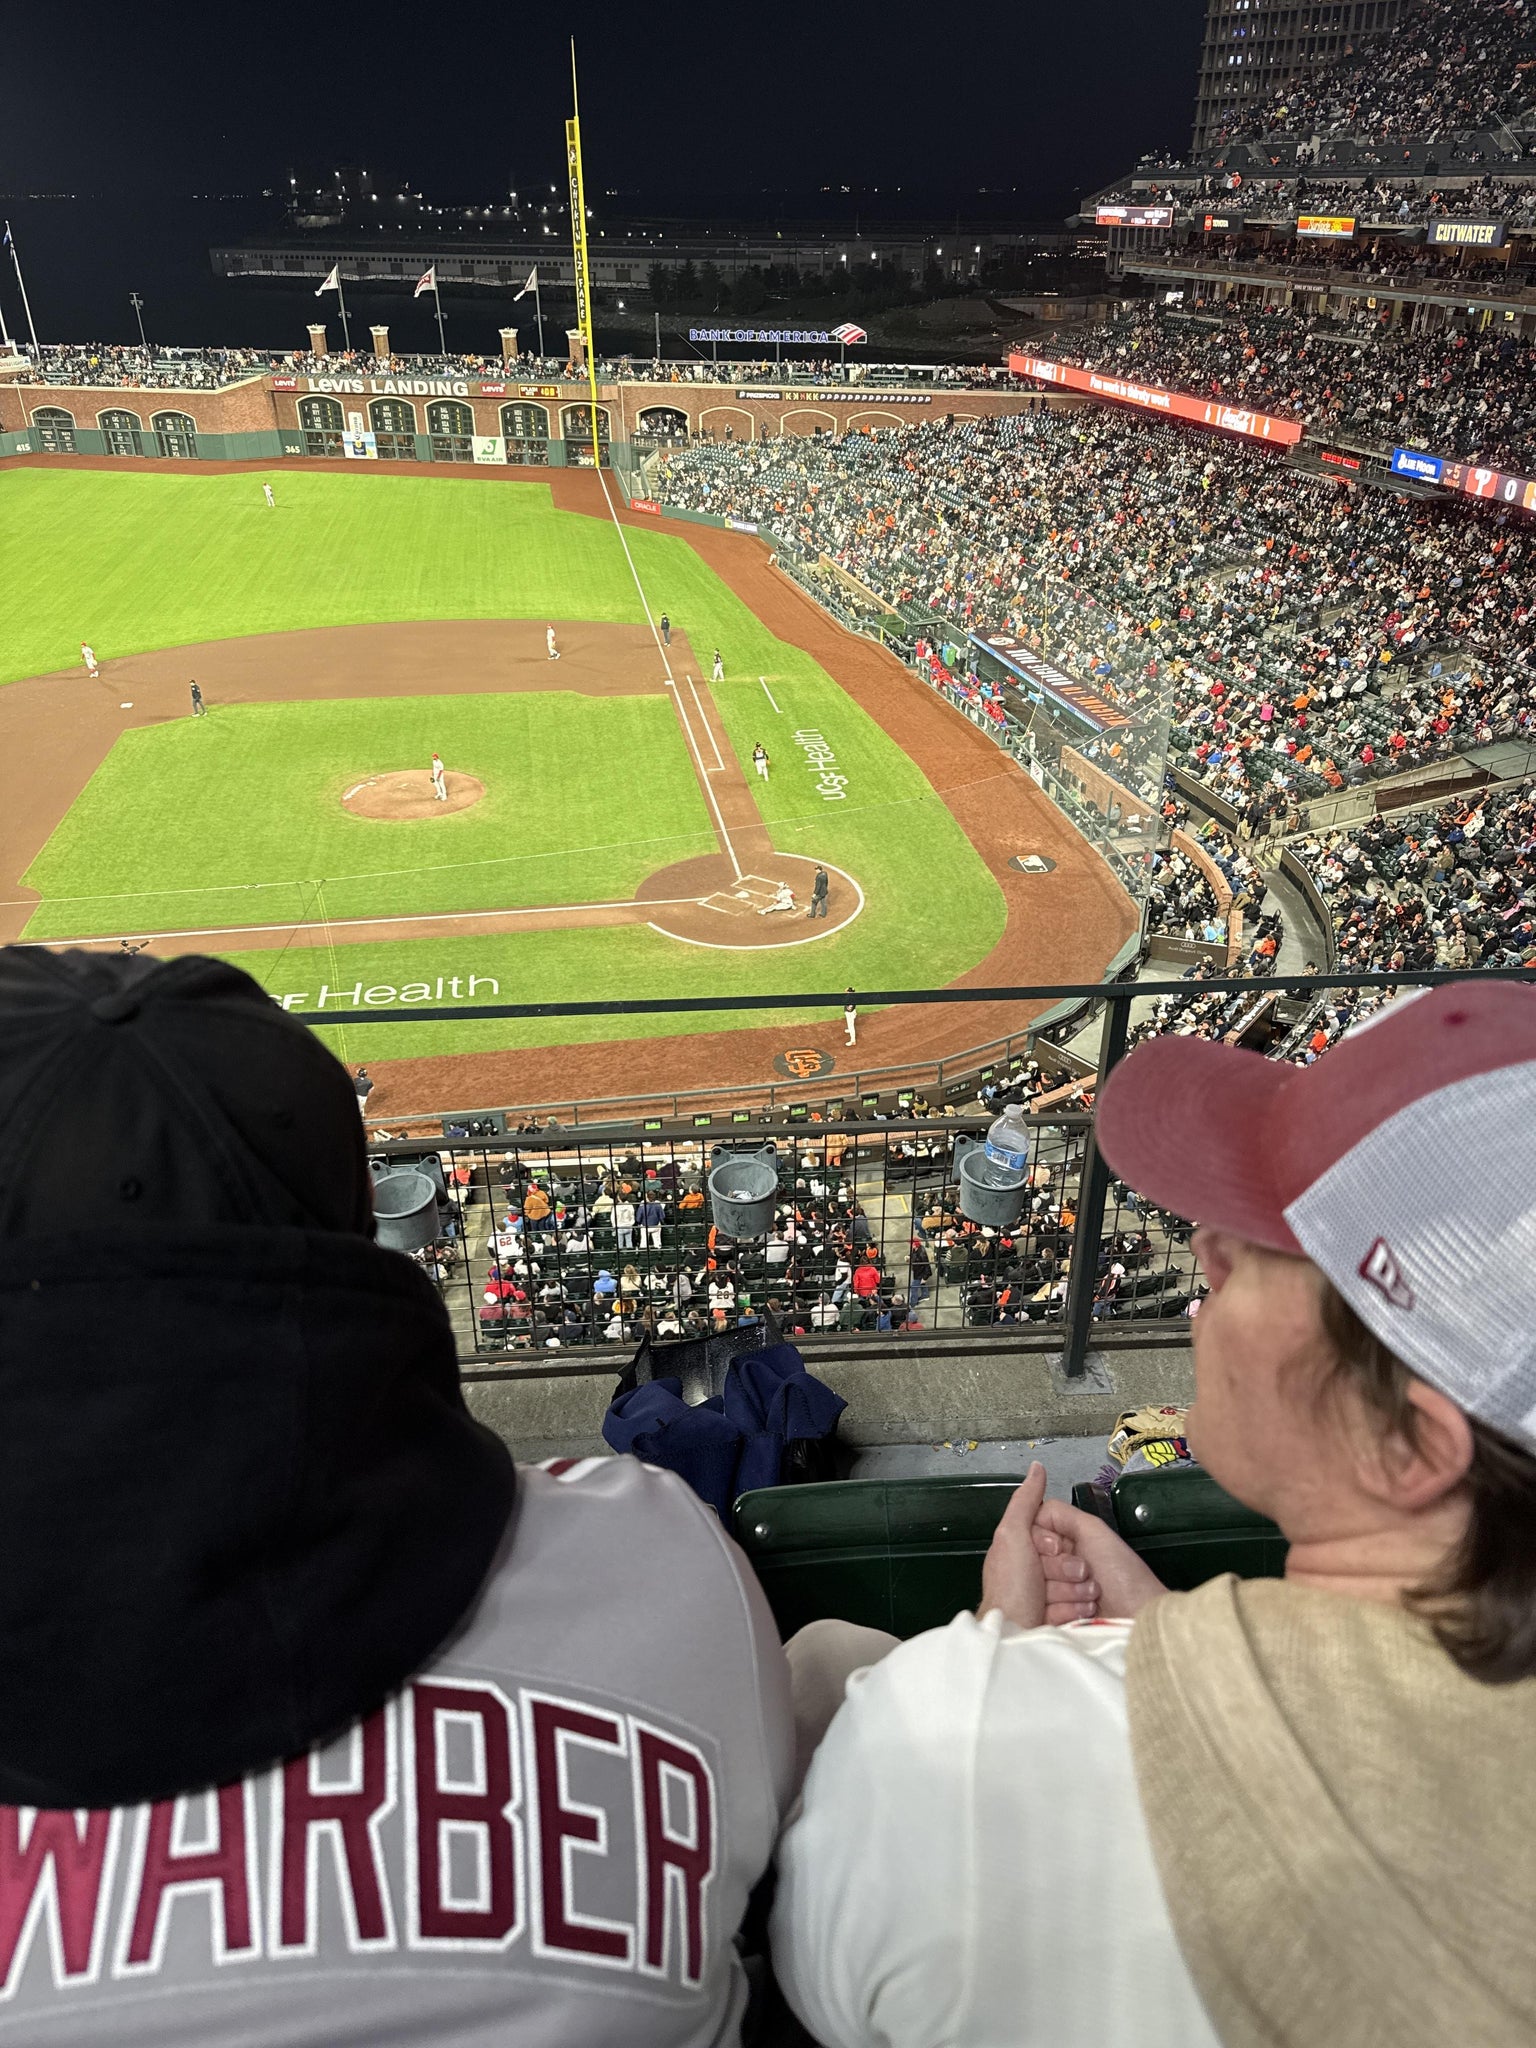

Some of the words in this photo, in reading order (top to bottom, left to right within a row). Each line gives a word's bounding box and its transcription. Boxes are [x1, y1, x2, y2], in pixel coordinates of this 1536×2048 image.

[571, 177, 581, 241] CHIKIN
[1435, 223, 1492, 244] CUTWATER
[576, 249, 583, 270] IZ
[578, 278, 586, 319] FARE
[689, 328, 732, 341] BANK
[735, 329, 757, 341] OF
[758, 330, 830, 343] AMERICA
[370, 379, 469, 396] LANDING
[16, 443, 31, 452] 415
[285, 445, 300, 454] 365
[579, 456, 595, 466] 309
[1453, 464, 1461, 479] 5
[1505, 479, 1517, 501] 0
[634, 502, 657, 512] ORACLE
[791, 728, 840, 772] Health
[317, 974, 499, 1009] Health
[499, 1236, 512, 1247] 62
[0, 1674, 717, 2001] WARBER
